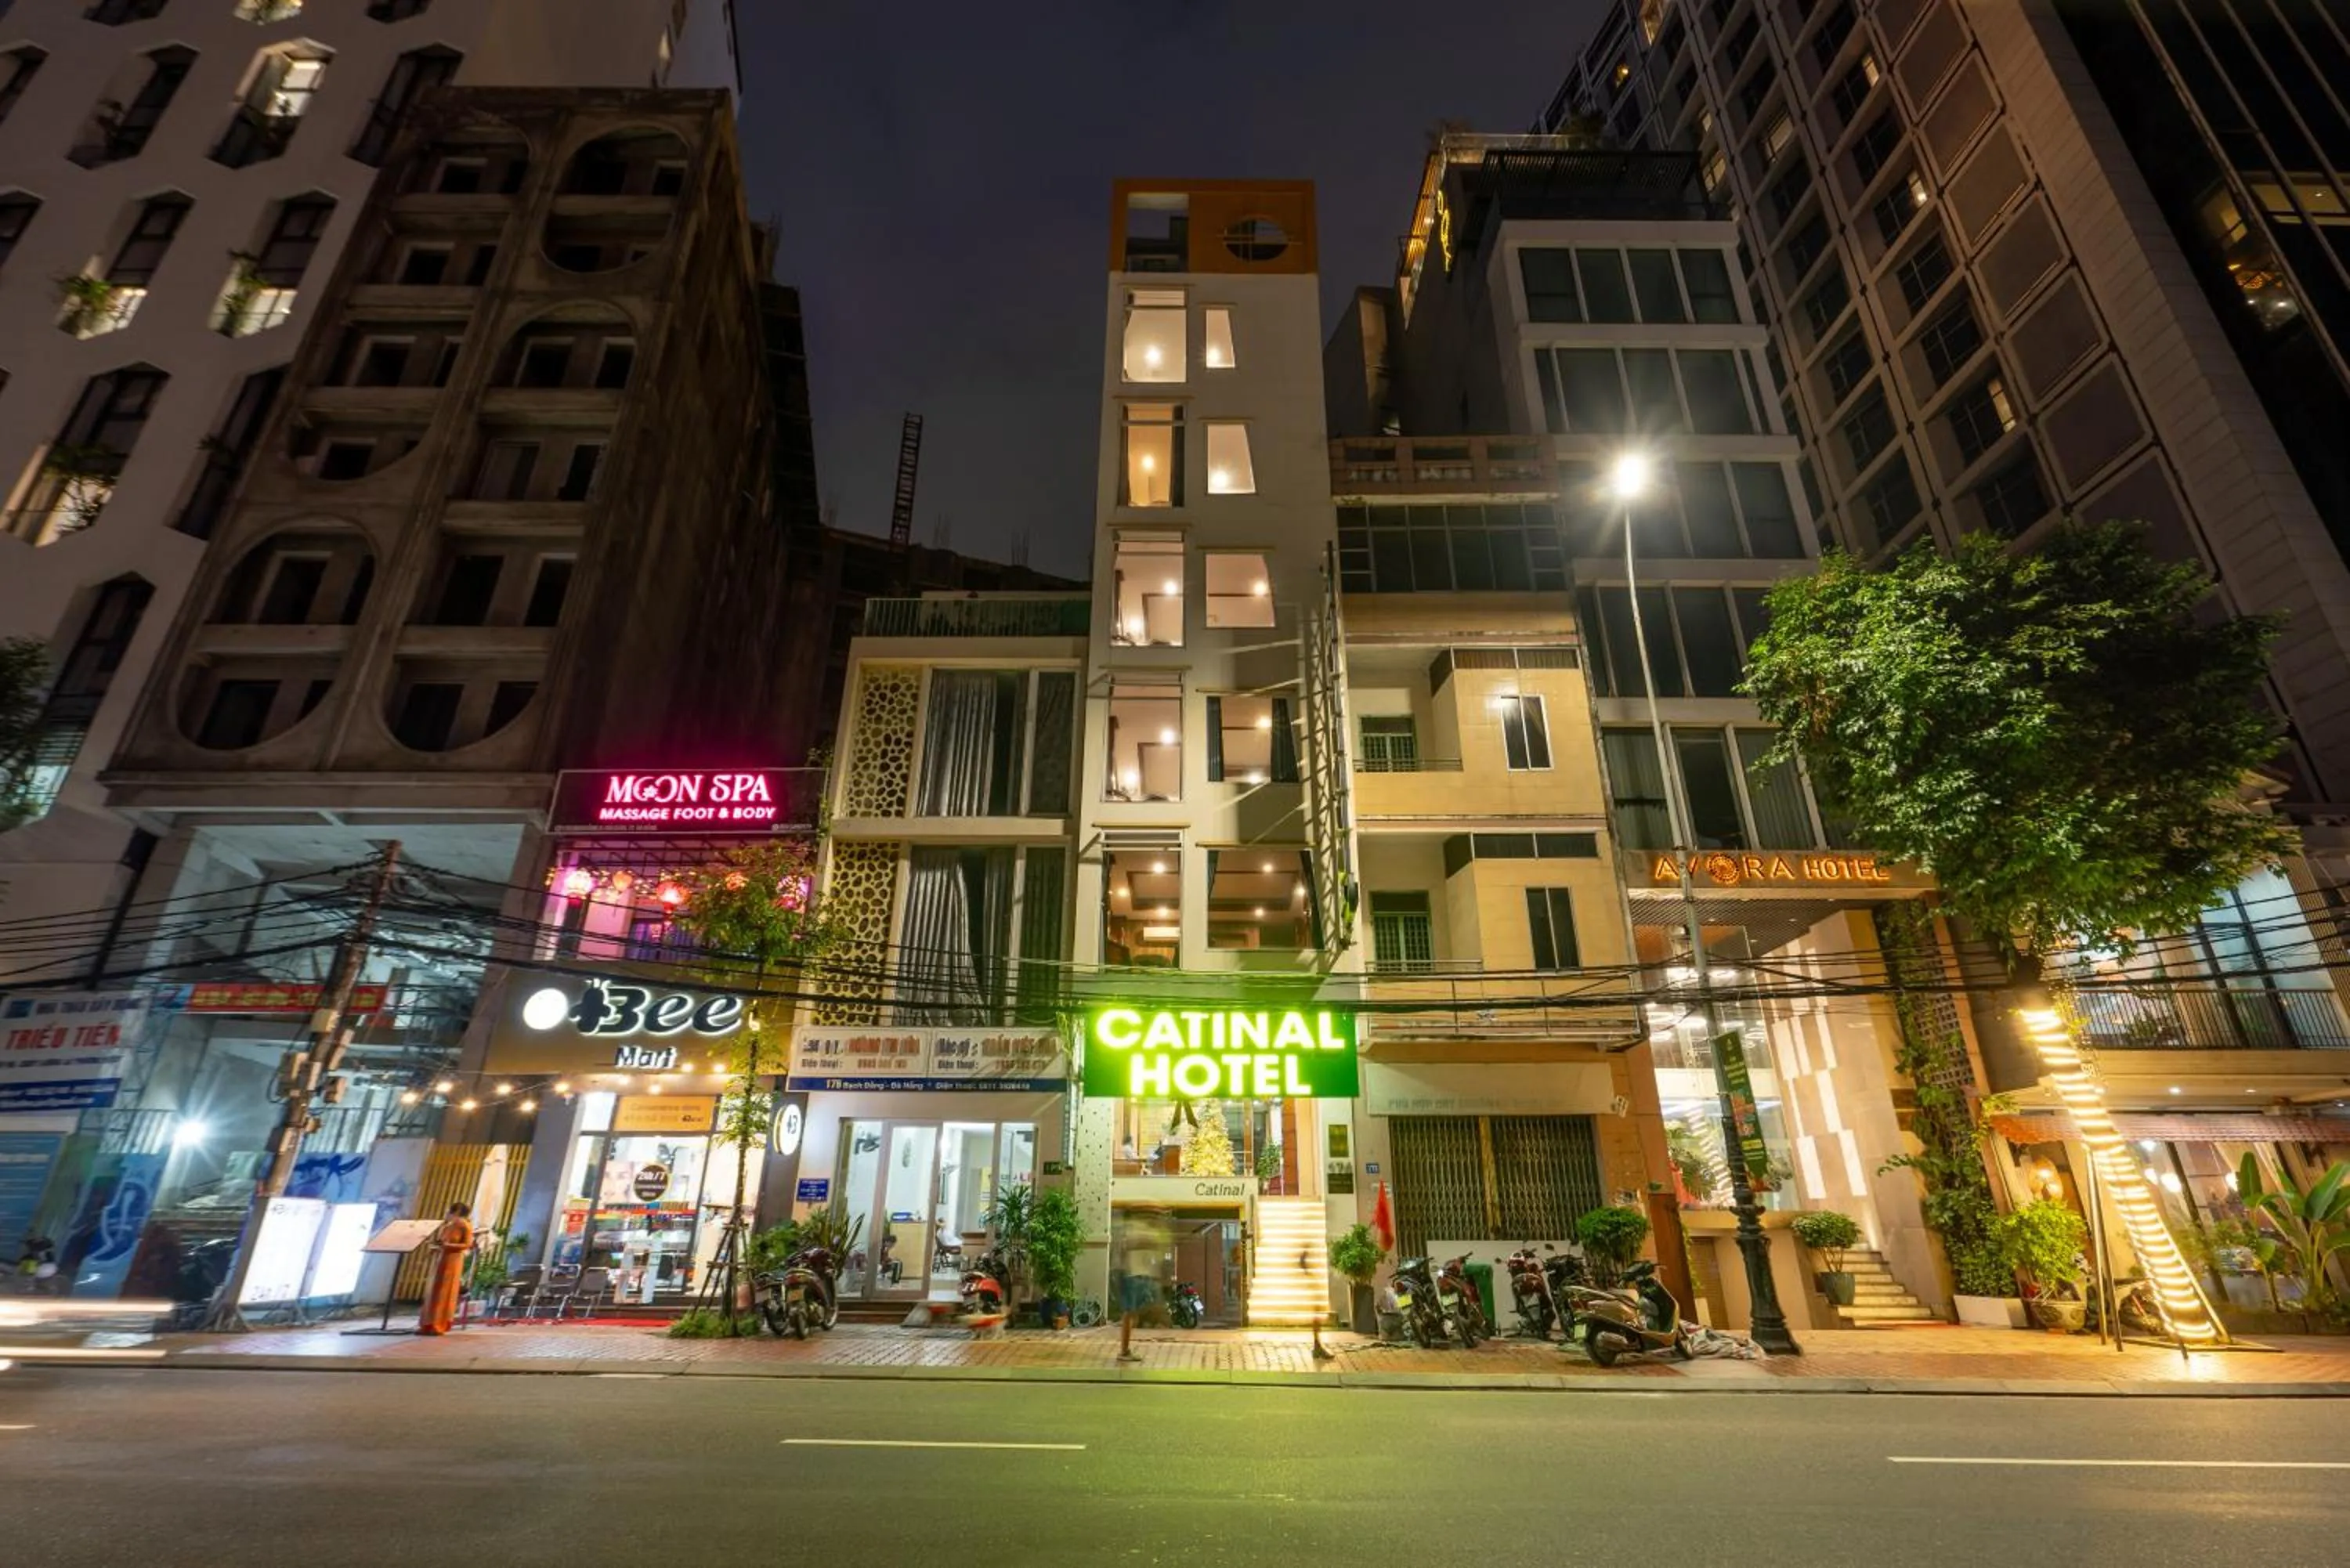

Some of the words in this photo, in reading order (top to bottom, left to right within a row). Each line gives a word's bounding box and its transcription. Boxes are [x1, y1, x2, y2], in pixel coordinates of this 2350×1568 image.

[604, 775, 703, 803] MOON
[709, 774, 772, 802] SPA
[599, 807, 669, 820] MASSAGE
[673, 807, 714, 820] FOOT
[718, 808, 728, 819] &
[732, 807, 776, 819] BODY
[1802, 856, 1889, 880] HOTEL
[578, 981, 743, 1036] Bee
[1097, 1009, 1345, 1050] CATINAL
[615, 1046, 677, 1068] Mart
[1130, 1054, 1311, 1096] HOTEL
[1195, 1182, 1246, 1197] Catinal
